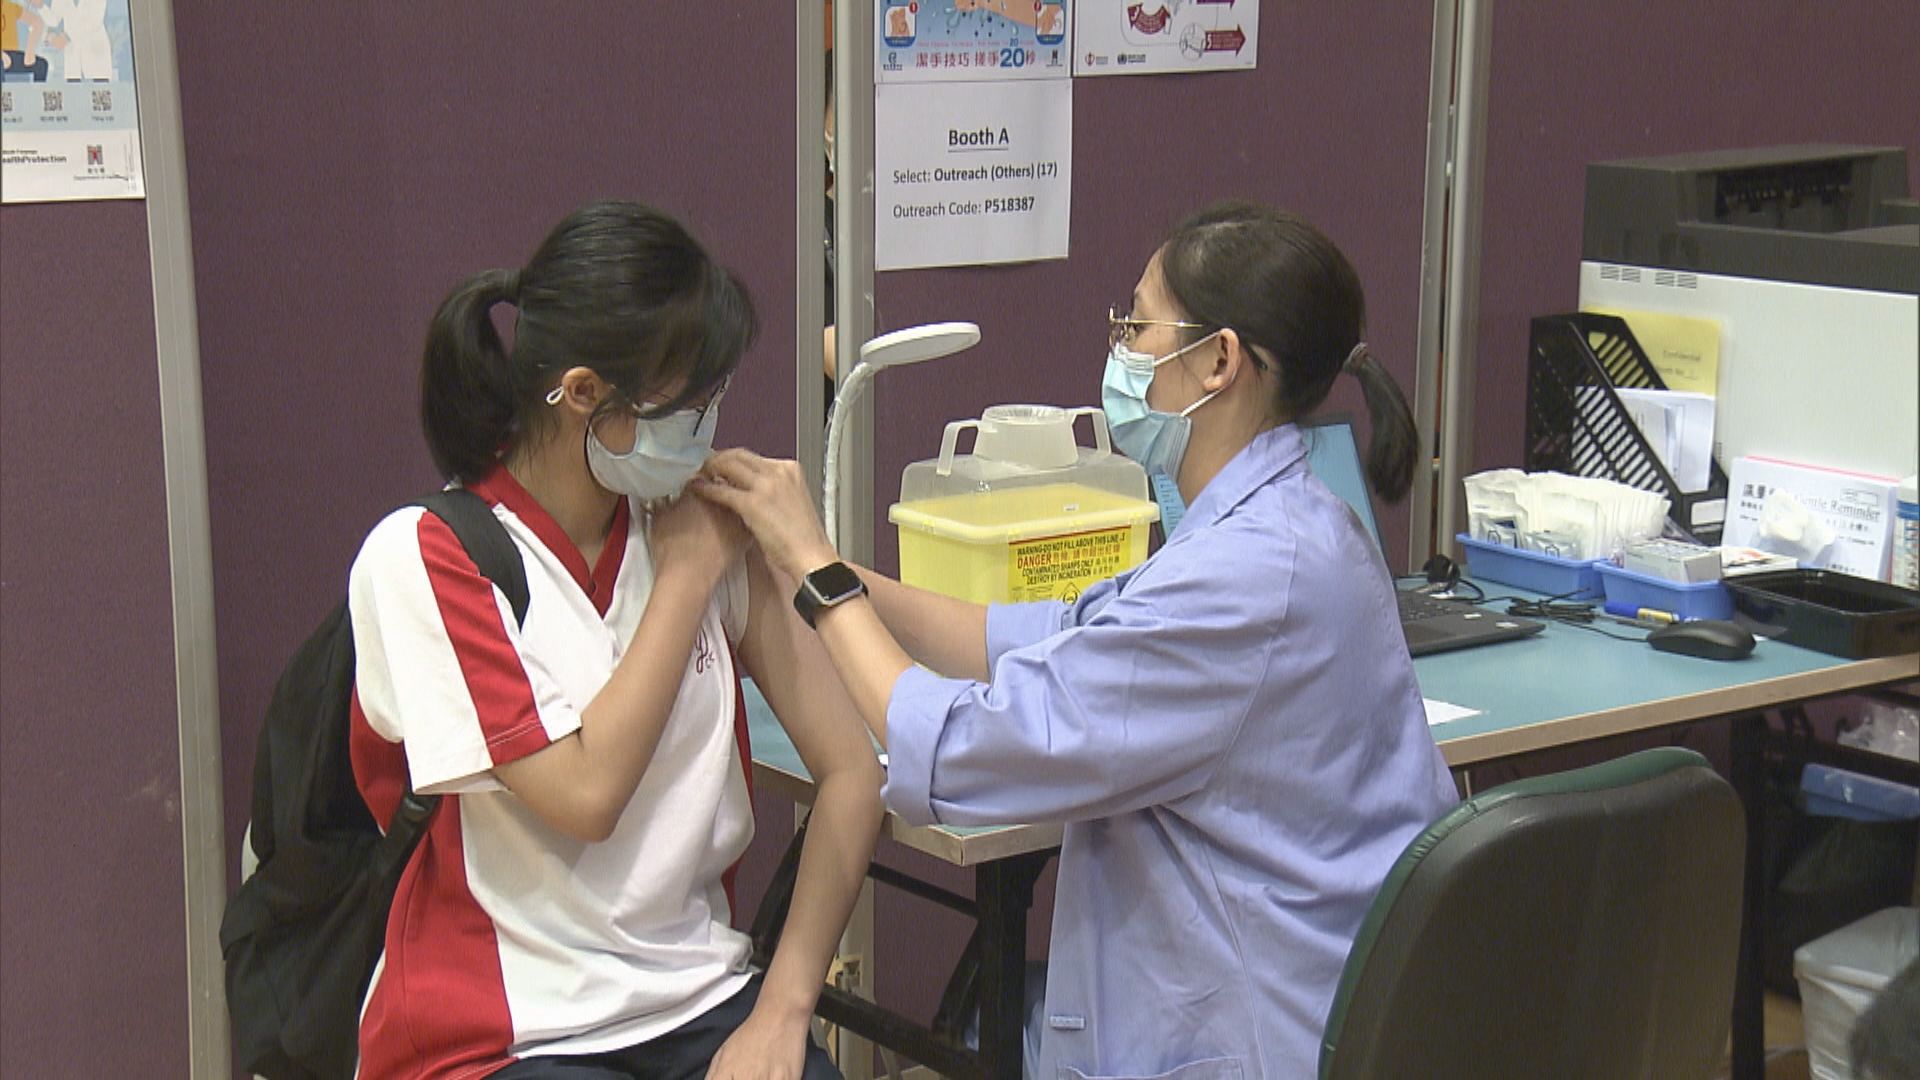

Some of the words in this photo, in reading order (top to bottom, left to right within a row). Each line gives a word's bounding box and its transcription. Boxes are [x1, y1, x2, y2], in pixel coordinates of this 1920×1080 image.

[916, 51, 970, 68] 潔手技巧
[949, 127, 994, 146] Booth
[998, 128, 1009, 145] A
[893, 169, 931, 184] Select:
[934, 166, 988, 182] Outreach
[991, 163, 1035, 182] (Others)
[1037, 161, 1058, 179] (17)
[893, 204, 945, 218] Outreach
[948, 201, 982, 216] Code:
[984, 196, 1035, 214] P518387
[1052, 542, 1063, 551] NOT
[1017, 553, 1052, 569] DANGER
[1050, 573, 1058, 582] BY
